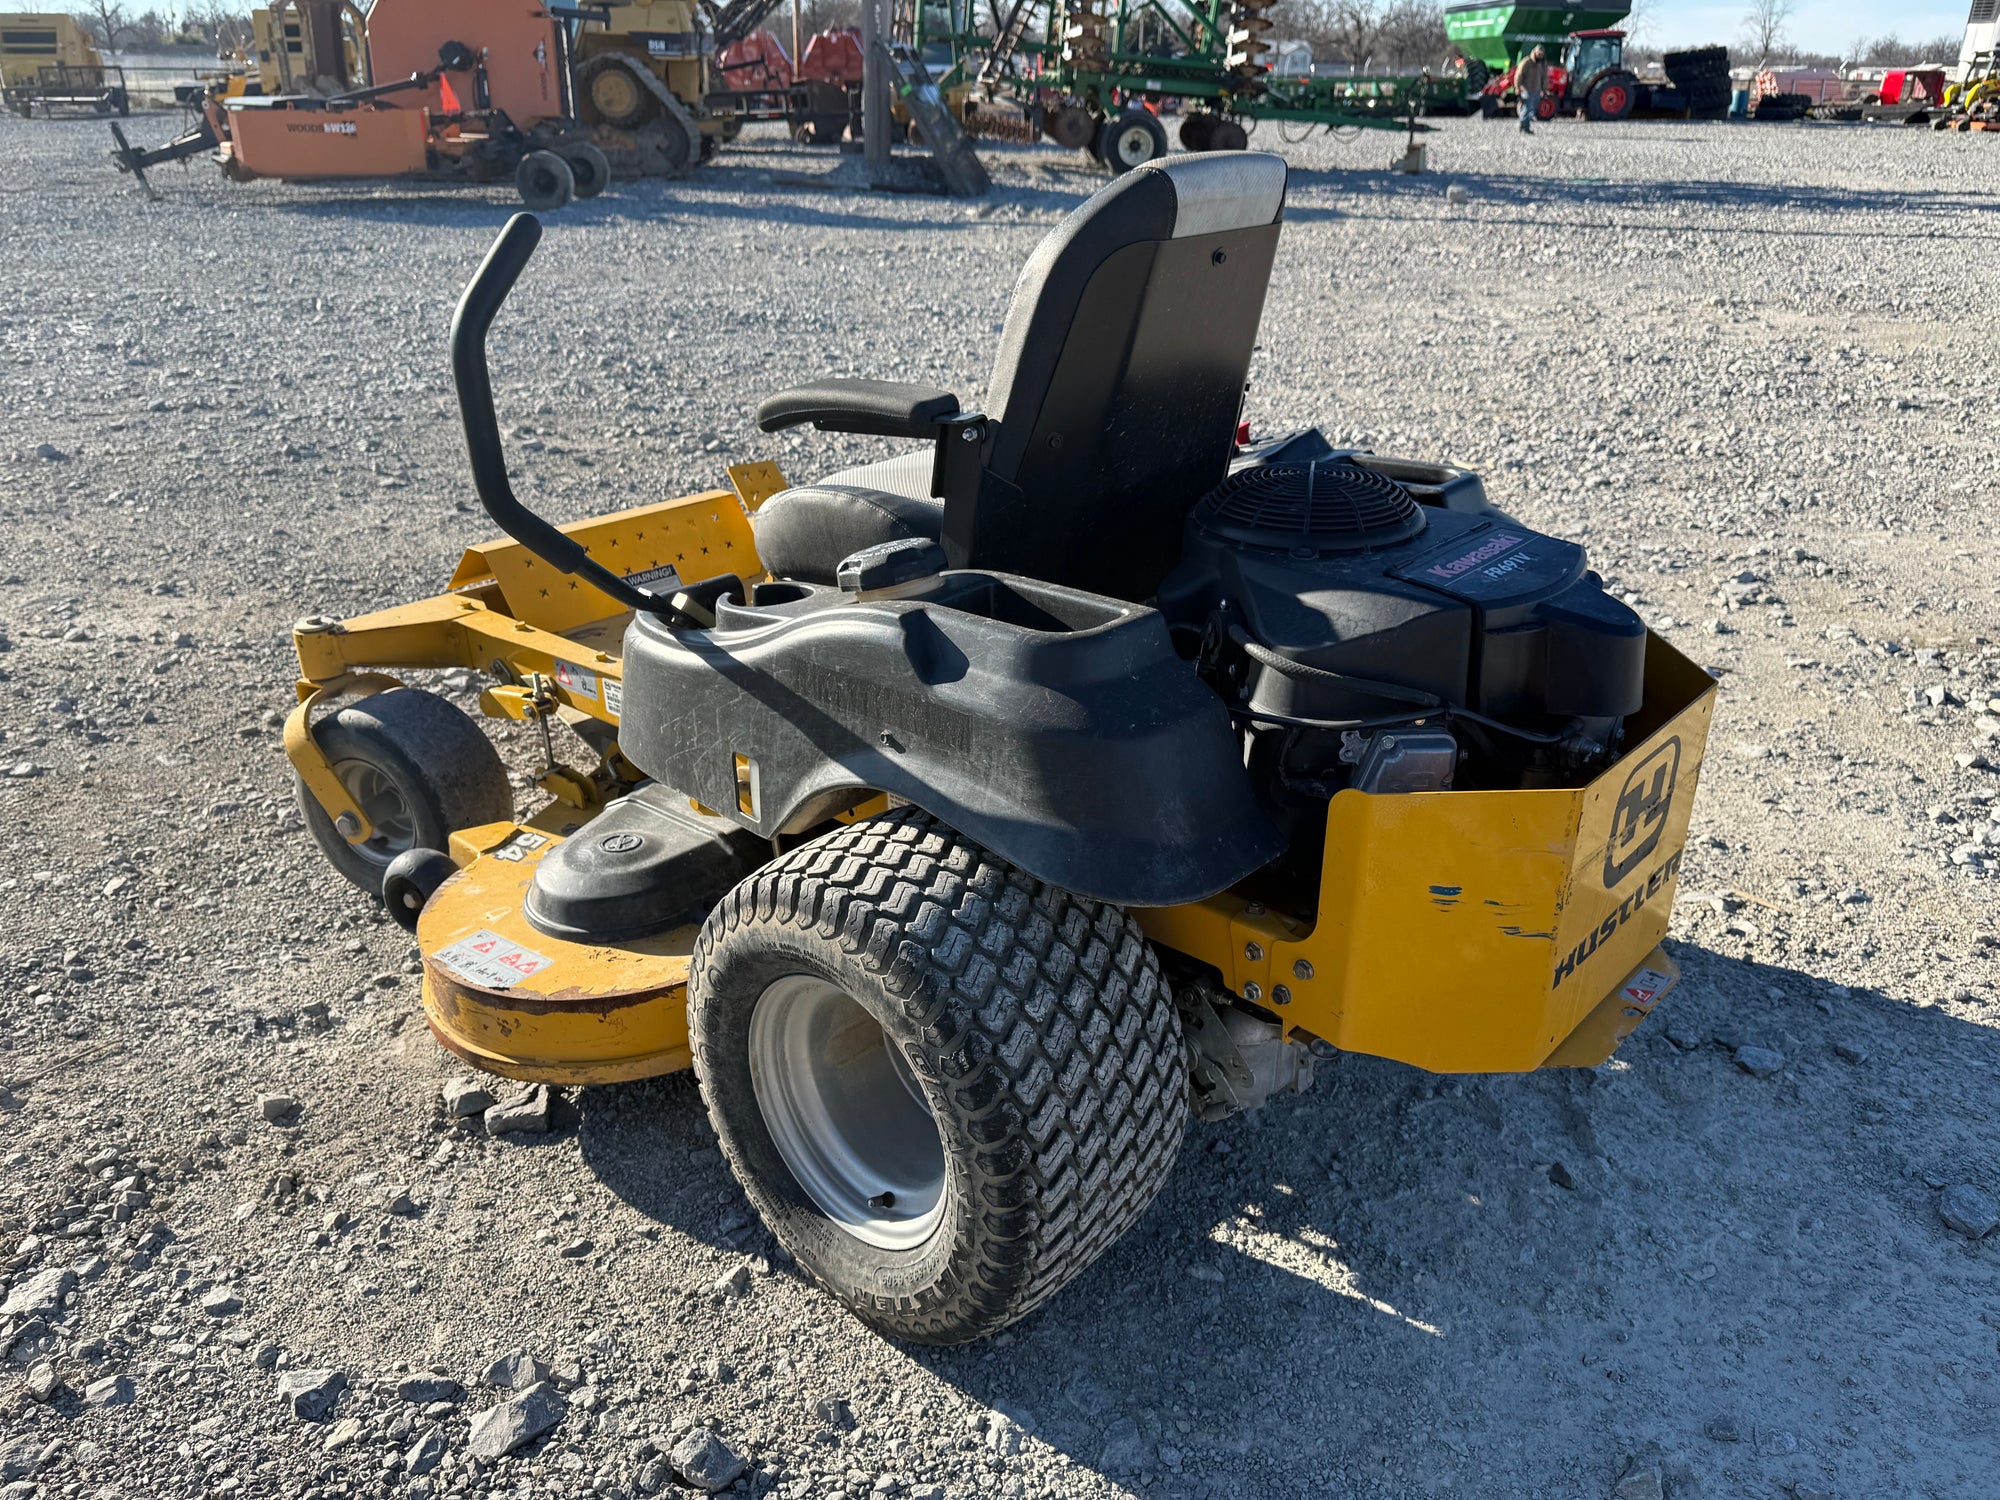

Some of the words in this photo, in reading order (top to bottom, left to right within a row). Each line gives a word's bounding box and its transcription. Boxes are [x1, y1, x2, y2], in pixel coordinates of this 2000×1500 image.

[1427, 534, 1522, 578] Kawasaki
[1483, 552, 1531, 578] FR691V
[627, 566, 673, 586] WARNING!
[494, 832, 549, 862] 54
[1552, 848, 1682, 991] HUSTLER
